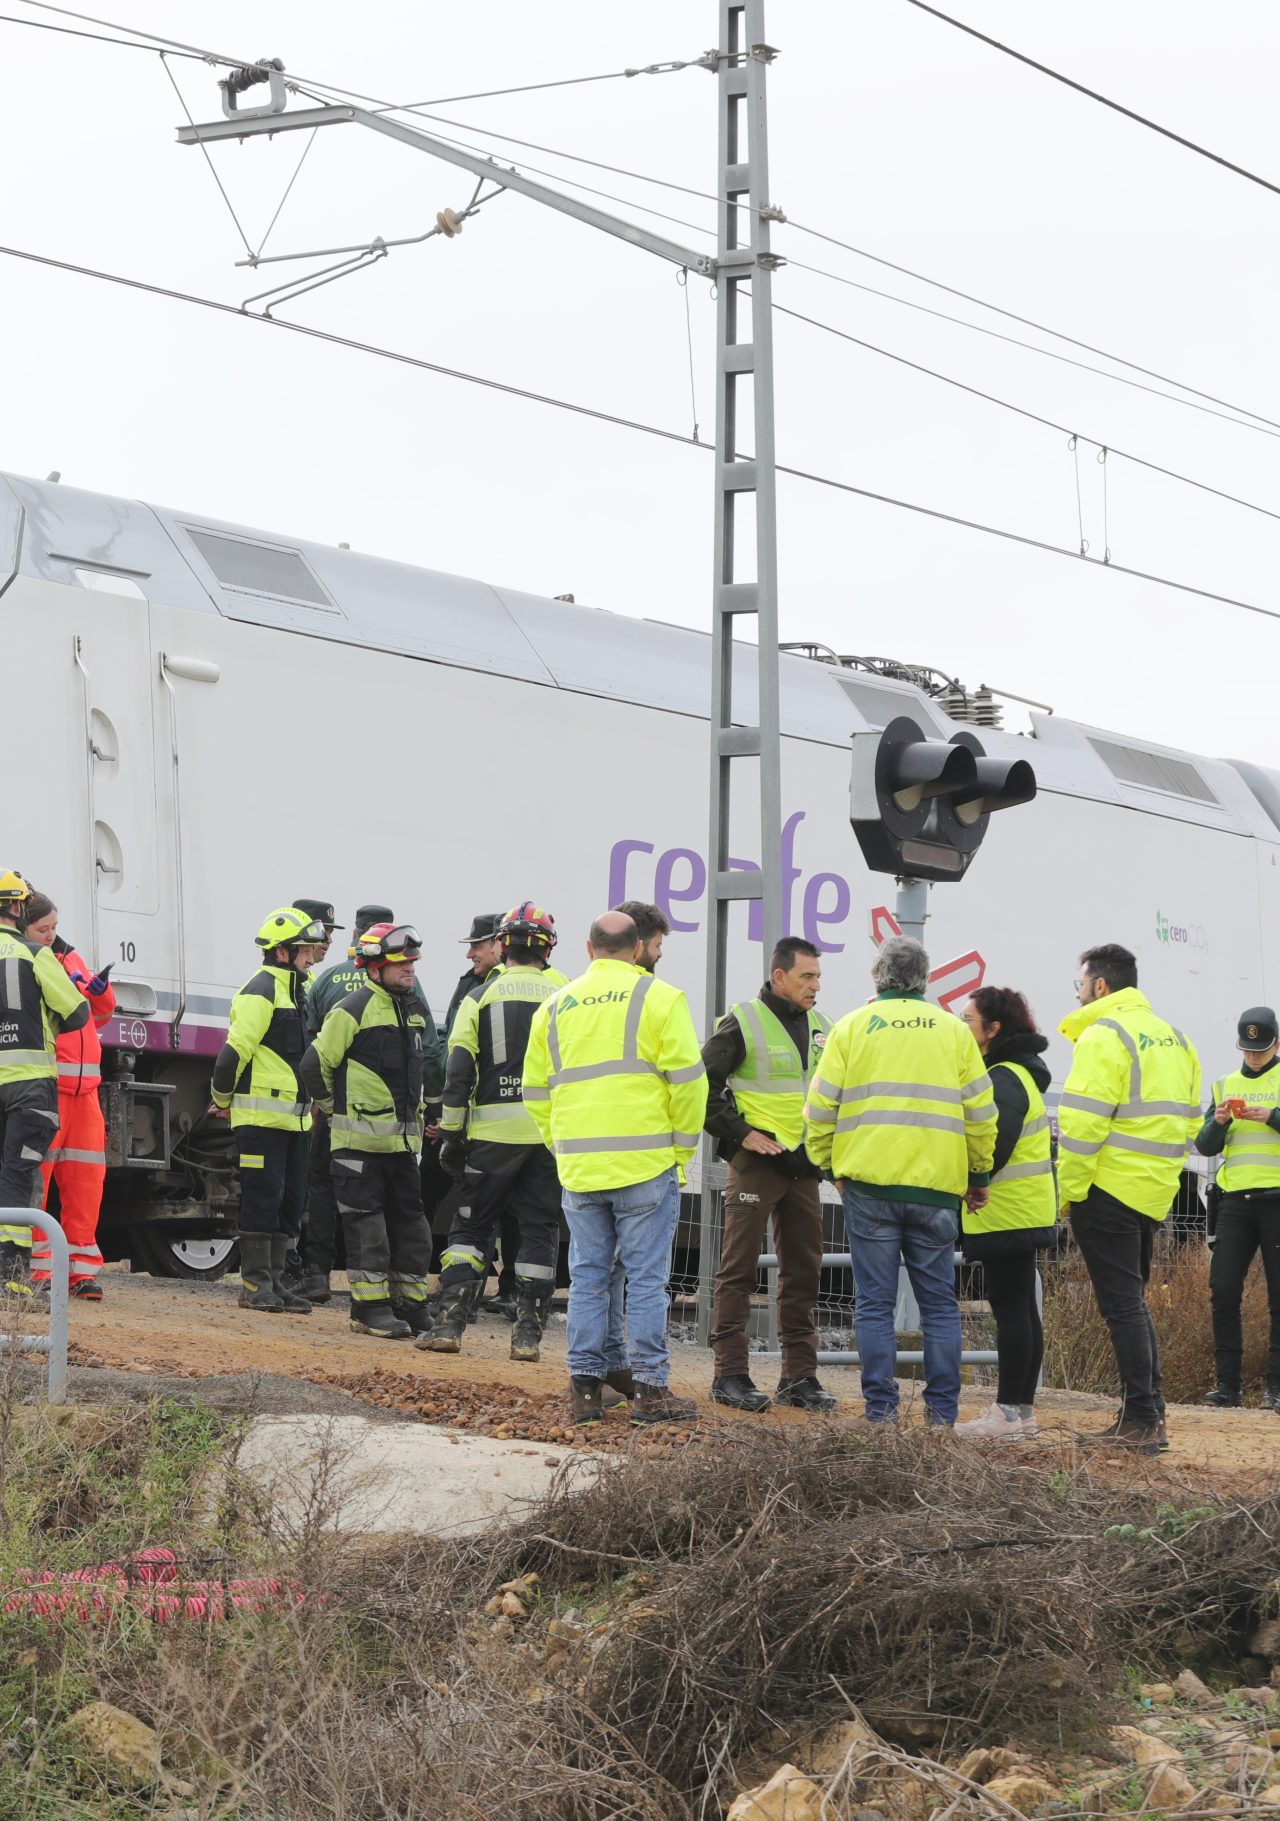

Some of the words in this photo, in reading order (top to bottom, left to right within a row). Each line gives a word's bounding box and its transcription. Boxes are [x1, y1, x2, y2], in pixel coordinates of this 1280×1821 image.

[1170, 926, 1187, 943] cero
[120, 941, 136, 963] 10
[498, 981, 561, 999] BOMBERO
[582, 990, 631, 1006] adif
[891, 1016, 937, 1029] adif
[500, 1087, 514, 1097] DE
